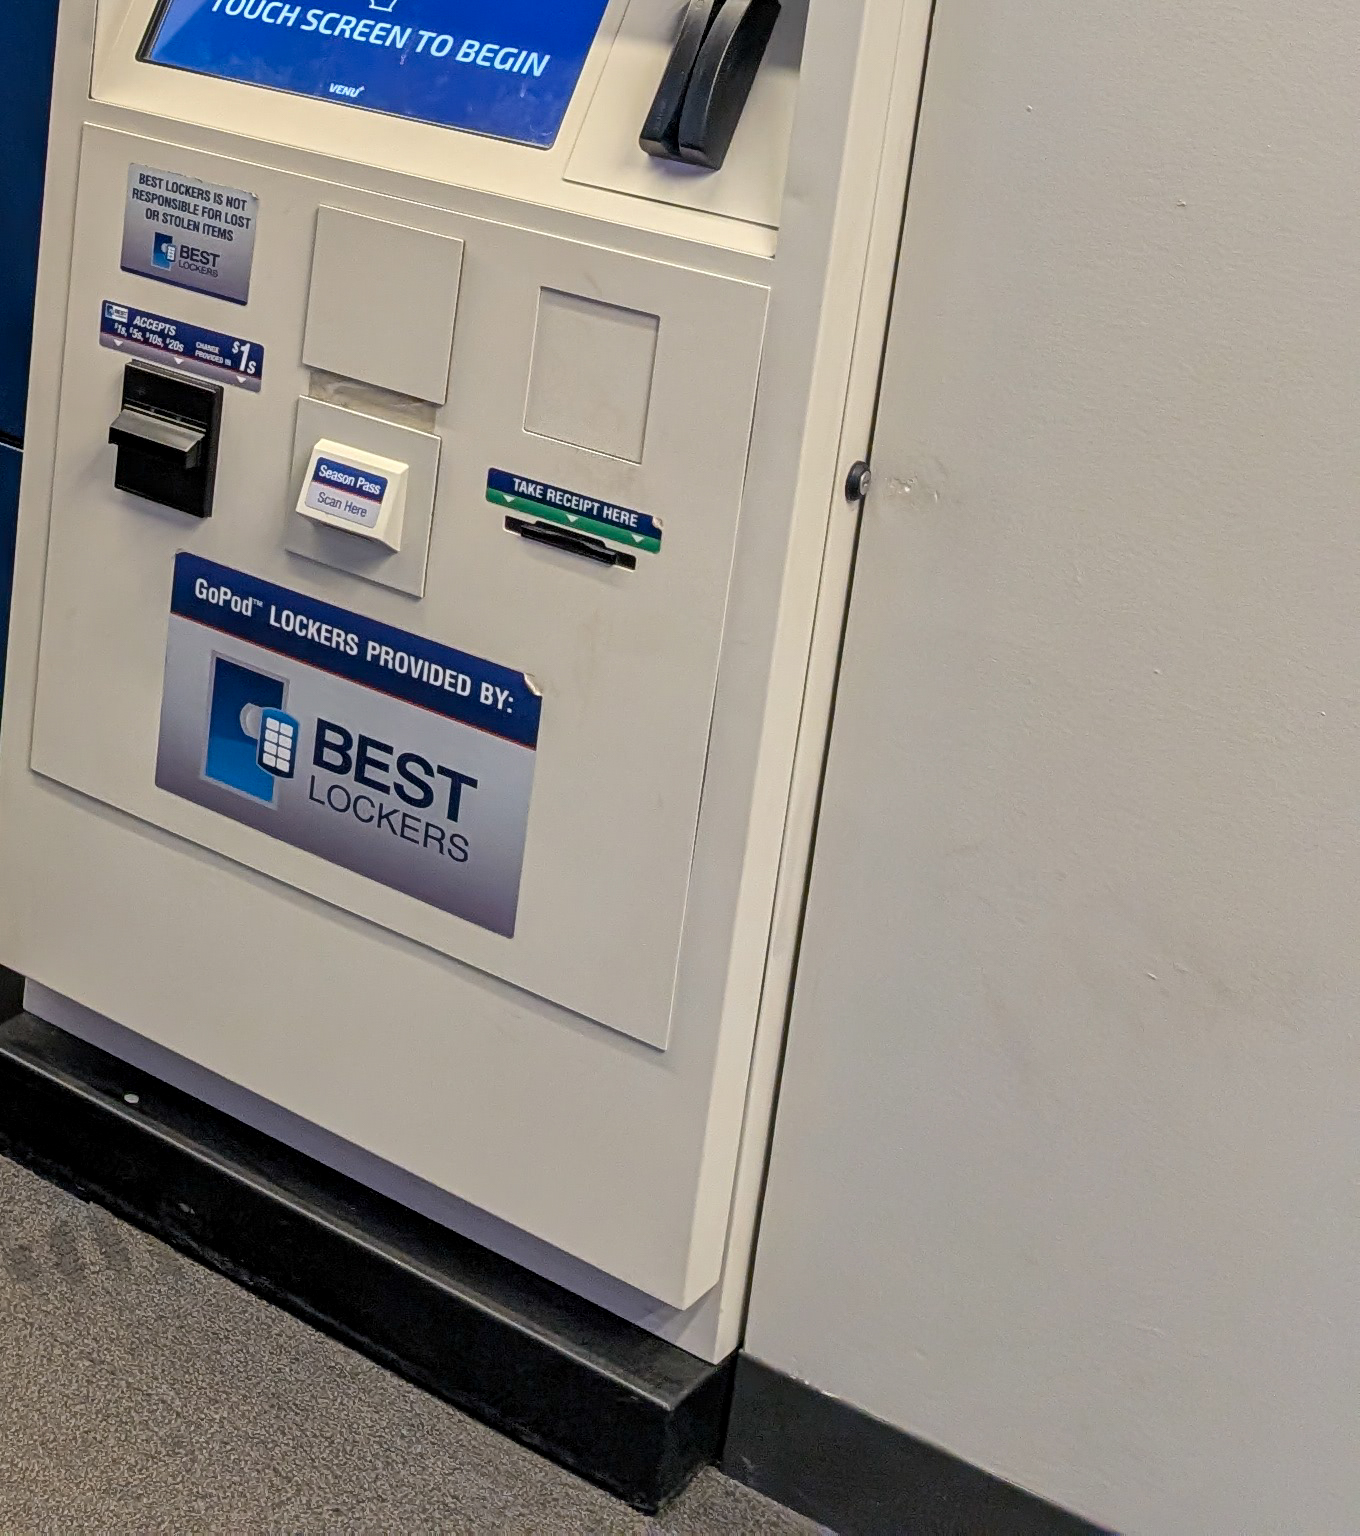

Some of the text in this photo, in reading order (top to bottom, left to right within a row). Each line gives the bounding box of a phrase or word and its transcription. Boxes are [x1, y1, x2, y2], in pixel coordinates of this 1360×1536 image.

[300, 8, 412, 49] SCREEN
[415, 30, 454, 57] TO
[456, 39, 550, 77] BEGIN
[132, 188, 251, 229] RESPONSIBLE FOR LOST
[139, 173, 248, 211] BEST LOCKERS IS NOT
[145, 208, 234, 241] OR STOLEN ITEMS
[178, 260, 218, 278] LOCKERS
[180, 245, 220, 267] BEST
[133, 315, 176, 336] ACCEPTS
[195, 350, 223, 364] PROVIDED
[318, 465, 381, 495] Season Pass
[317, 492, 367, 518] Scan Here
[512, 477, 638, 527] TAKE RECEIPT HERE
[270, 605, 359, 656] LOCKERS
[367, 641, 471, 697] PROVIDED
[480, 682, 514, 713] BY:
[312, 718, 478, 822] BEST
[308, 774, 469, 863] LOCKERS
